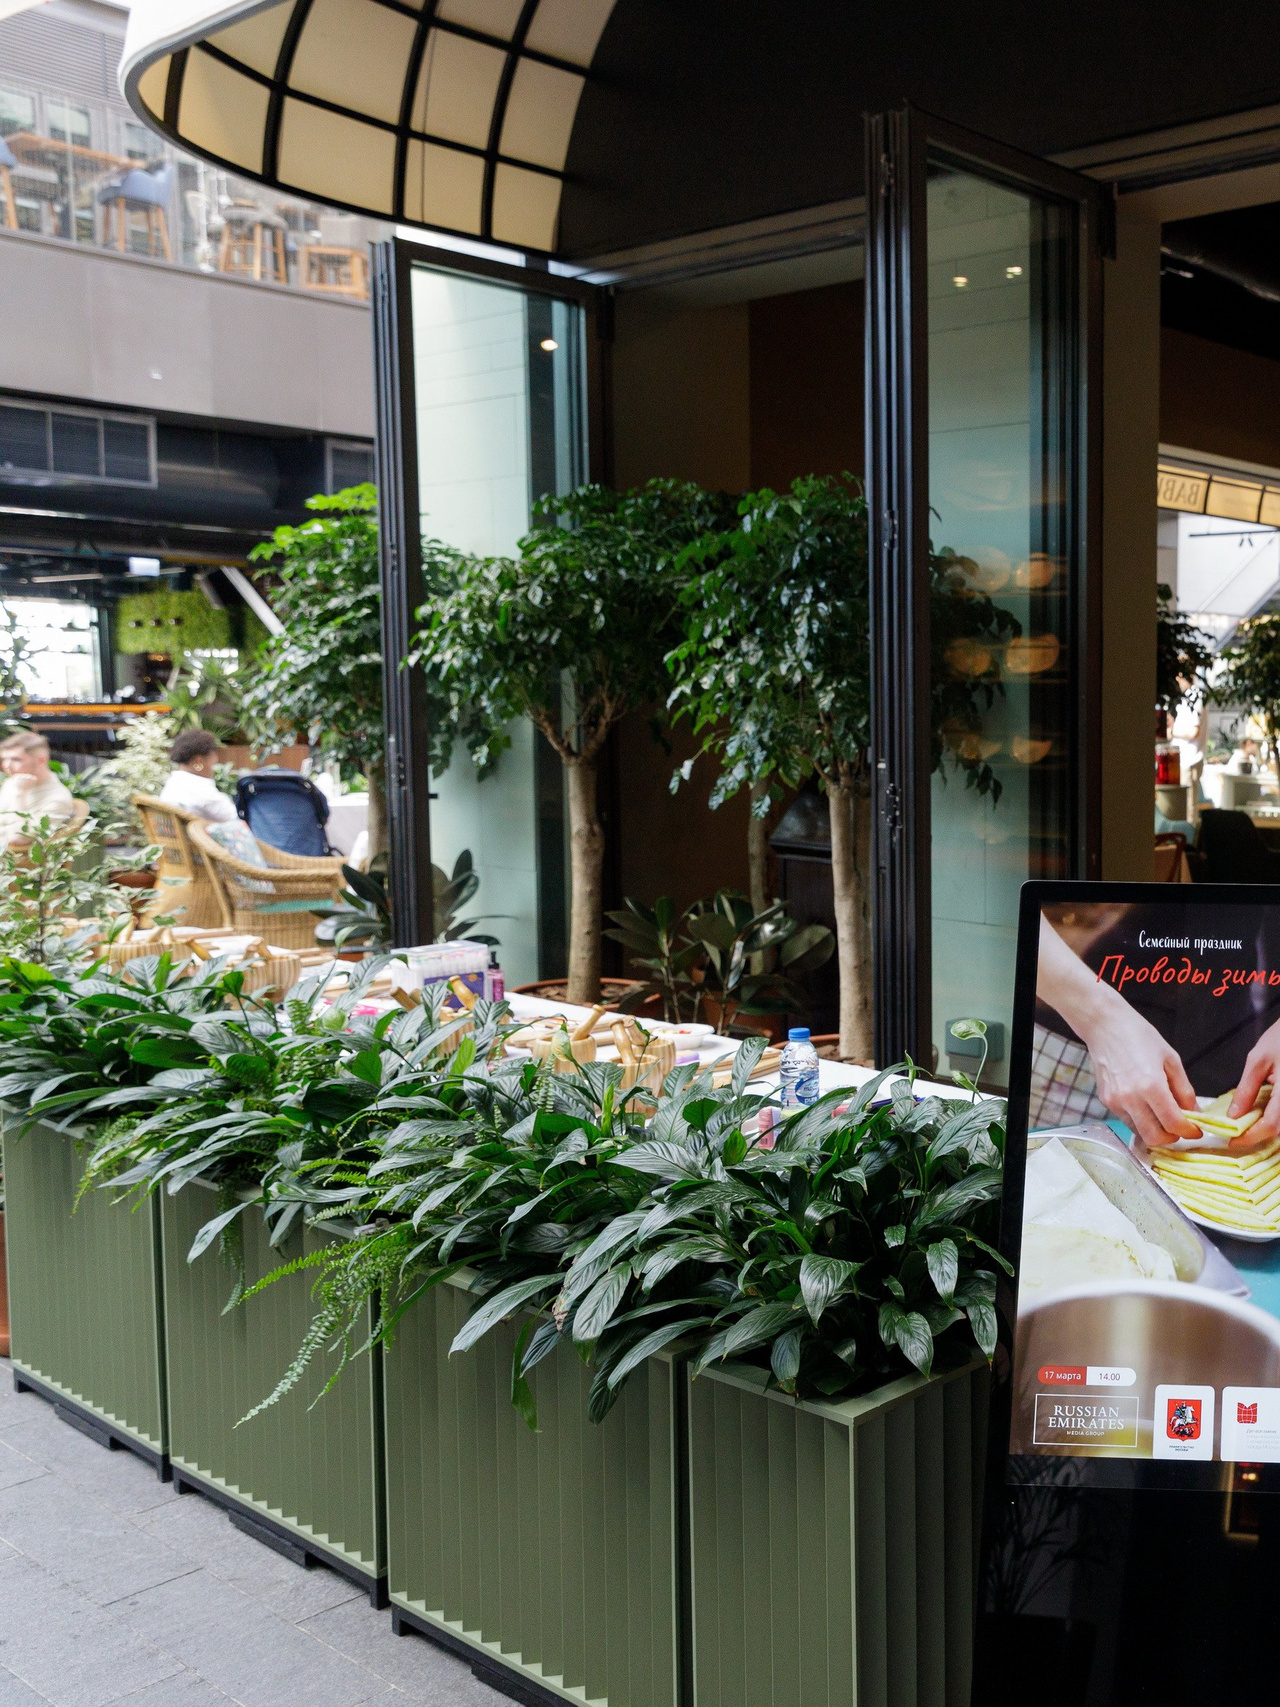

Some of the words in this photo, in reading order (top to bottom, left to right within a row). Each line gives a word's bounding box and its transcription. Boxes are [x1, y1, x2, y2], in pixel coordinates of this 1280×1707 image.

[1138, 929, 1190, 949] Семейный
[1194, 937, 1243, 956] праздник
[1096, 954, 1212, 992] Проводы
[1044, 1371, 1055, 1379] 17
[1056, 1373, 1082, 1381] марта
[1099, 1373, 1121, 1381] 14.00
[1053, 1405, 1120, 1418] RUSSIAN
[1048, 1416, 1124, 1430] EMIRATES
